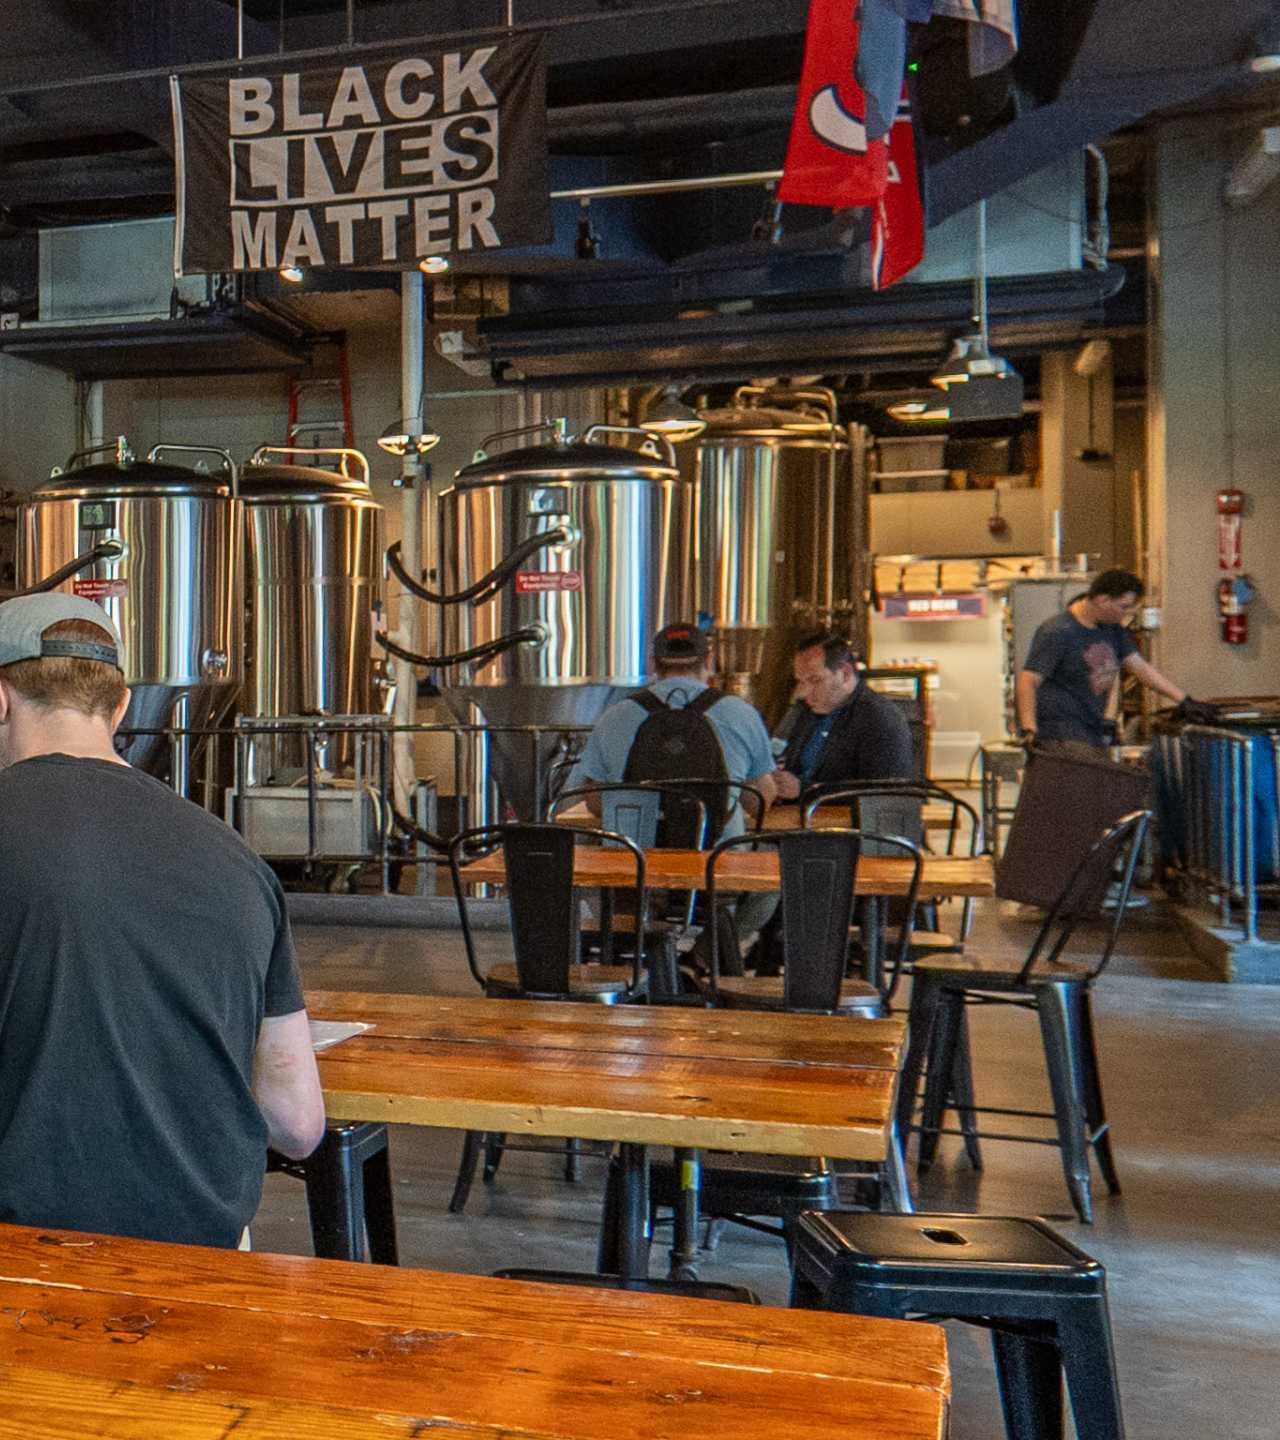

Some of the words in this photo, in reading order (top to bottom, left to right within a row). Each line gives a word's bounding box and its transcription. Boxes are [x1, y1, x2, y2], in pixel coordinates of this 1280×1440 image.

[229, 46, 498, 135] BLACK
[233, 116, 495, 201] LIVES
[231, 187, 501, 270] MATTER
